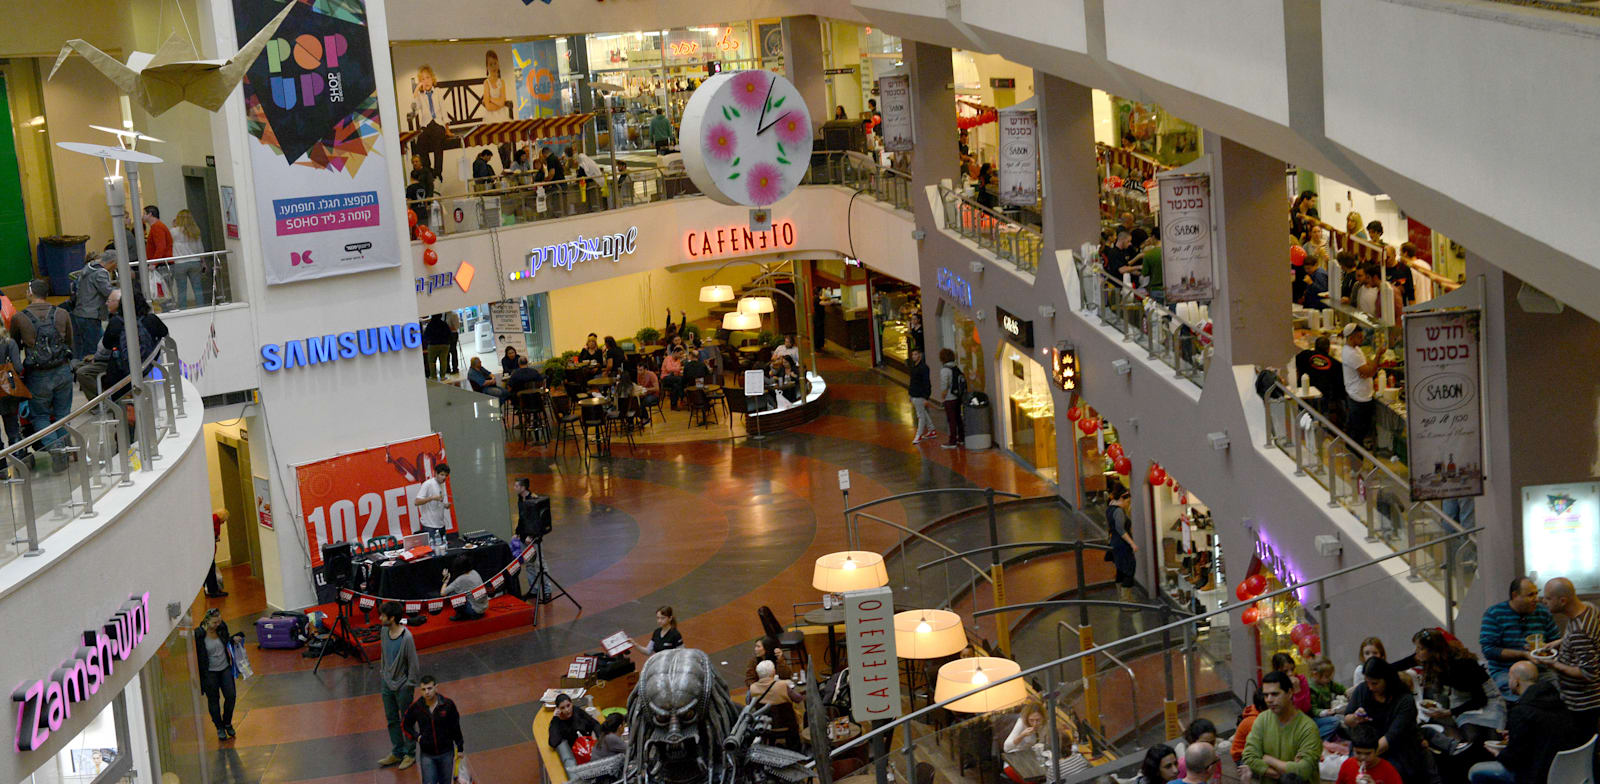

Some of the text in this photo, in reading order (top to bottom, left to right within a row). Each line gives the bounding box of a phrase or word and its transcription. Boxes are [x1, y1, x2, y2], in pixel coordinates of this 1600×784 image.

[266, 33, 348, 73] POP
[270, 72, 325, 111] UP
[328, 72, 340, 103] SHOP
[1173, 184, 1200, 197] חדש
[1167, 198, 1204, 211] בסנטר
[286, 216, 319, 230] SOHO
[320, 213, 336, 225] ליד
[348, 210, 371, 222] קומה
[1174, 224, 1200, 237] SABON
[1425, 324, 1464, 342] חדש
[261, 322, 422, 372] SAMSUNG
[1416, 344, 1470, 362] בסנטר
[1427, 383, 1464, 401] SABON
